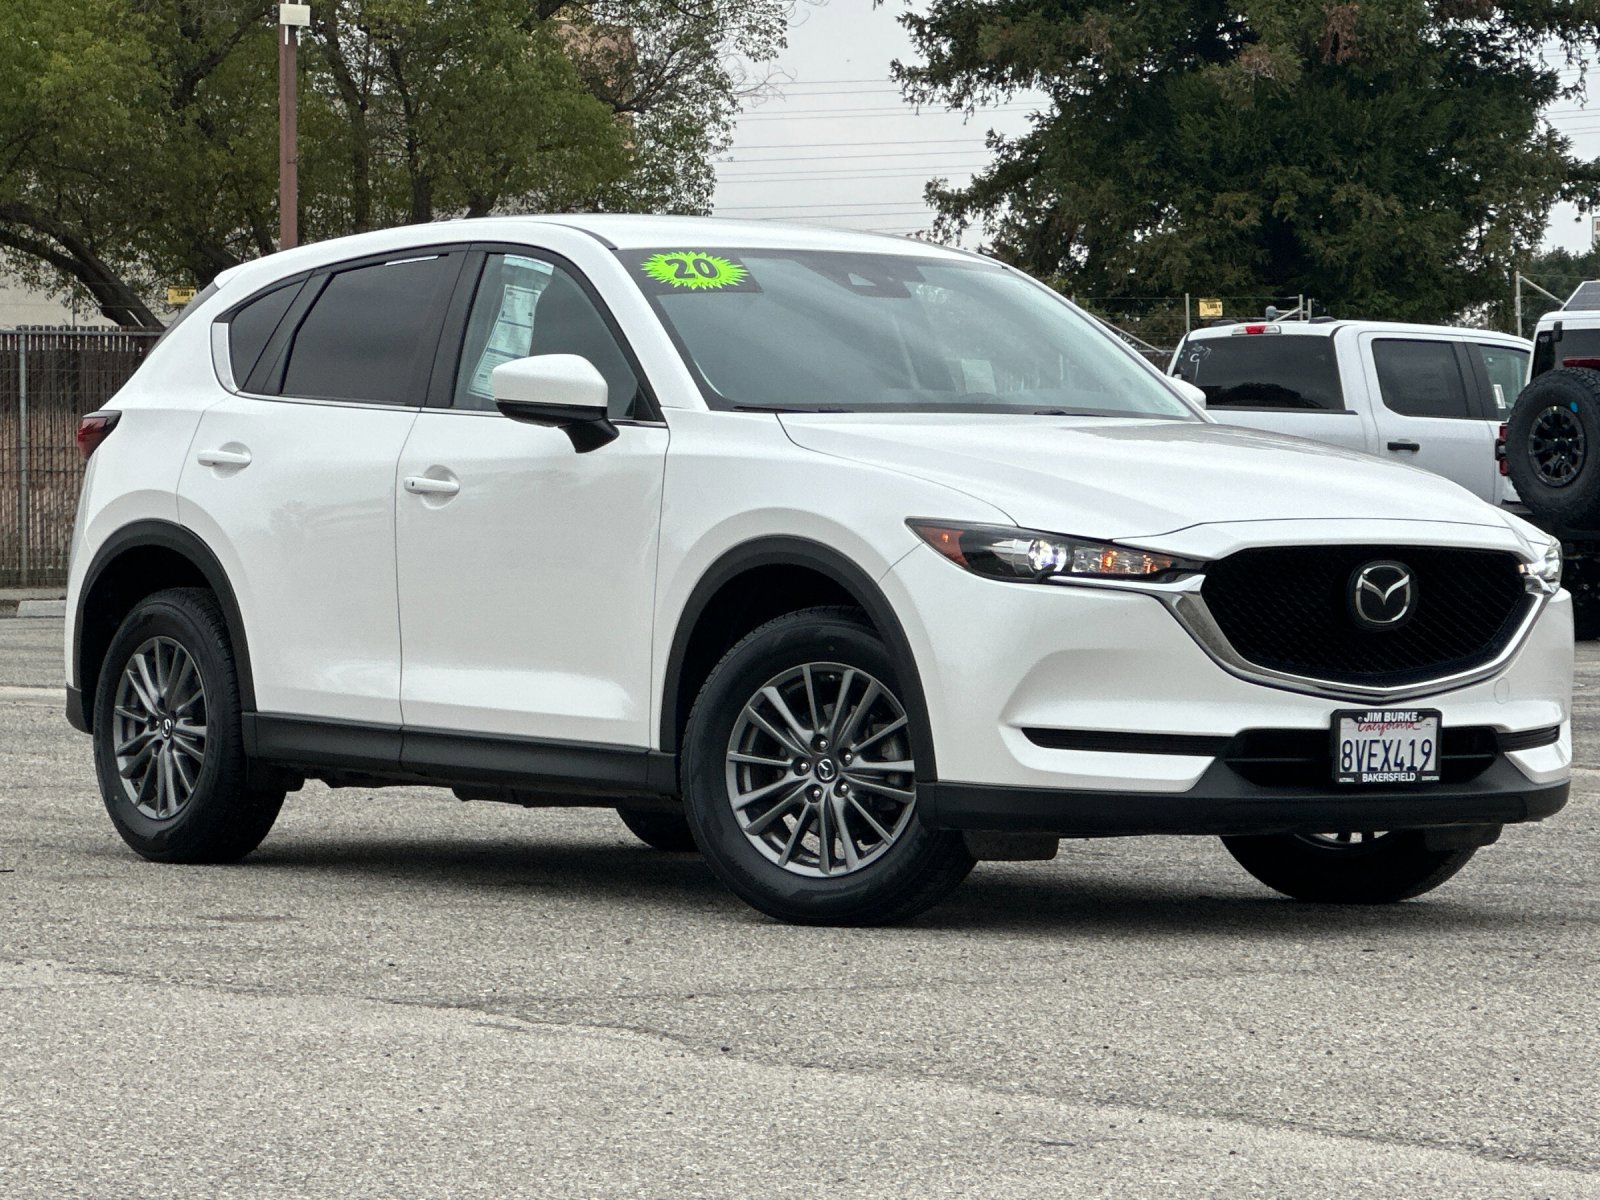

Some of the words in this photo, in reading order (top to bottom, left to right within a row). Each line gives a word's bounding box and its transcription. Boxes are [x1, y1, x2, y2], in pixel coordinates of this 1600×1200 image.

[664, 258, 719, 279] 20
[1364, 711, 1382, 722] JIM
[1384, 711, 1418, 722] BURKE
[1341, 738, 1433, 772] 8VEX419
[1362, 772, 1416, 782] BAKERSFIELD
